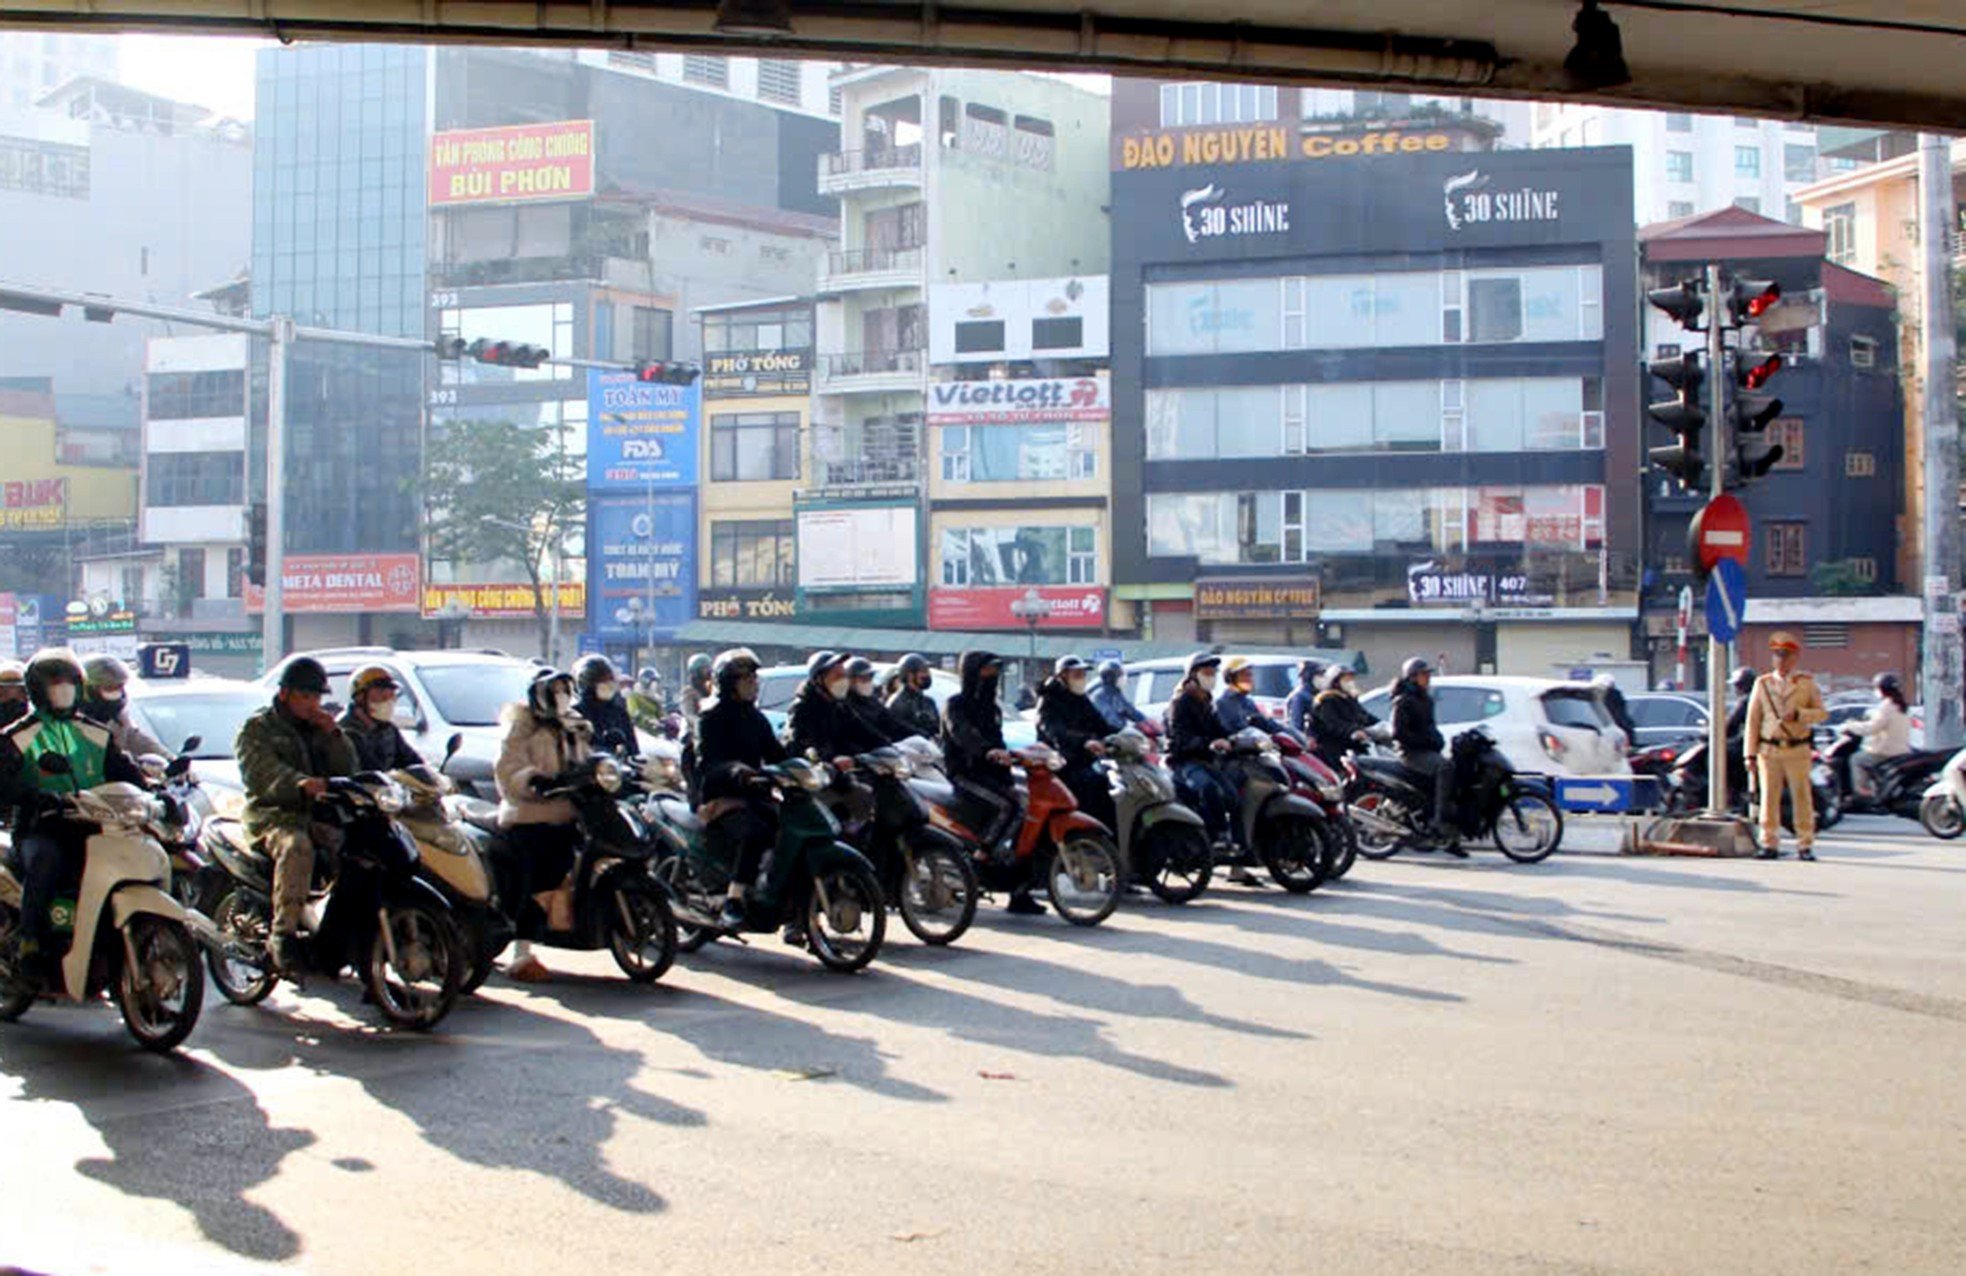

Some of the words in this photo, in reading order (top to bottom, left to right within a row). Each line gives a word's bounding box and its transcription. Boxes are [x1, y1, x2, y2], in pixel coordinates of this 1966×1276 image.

[1302, 131, 1451, 158] Coffee
[450, 167, 493, 197] BÙI
[500, 164, 571, 194] PHƠN
[1200, 206, 1226, 236] 30
[1464, 193, 1491, 223] 30
[934, 382, 1064, 405] Vietlott
[622, 440, 663, 459] FDA
[326, 572, 383, 588] DENTAL
[1499, 576, 1526, 590] 407
[155, 648, 179, 674] G7
